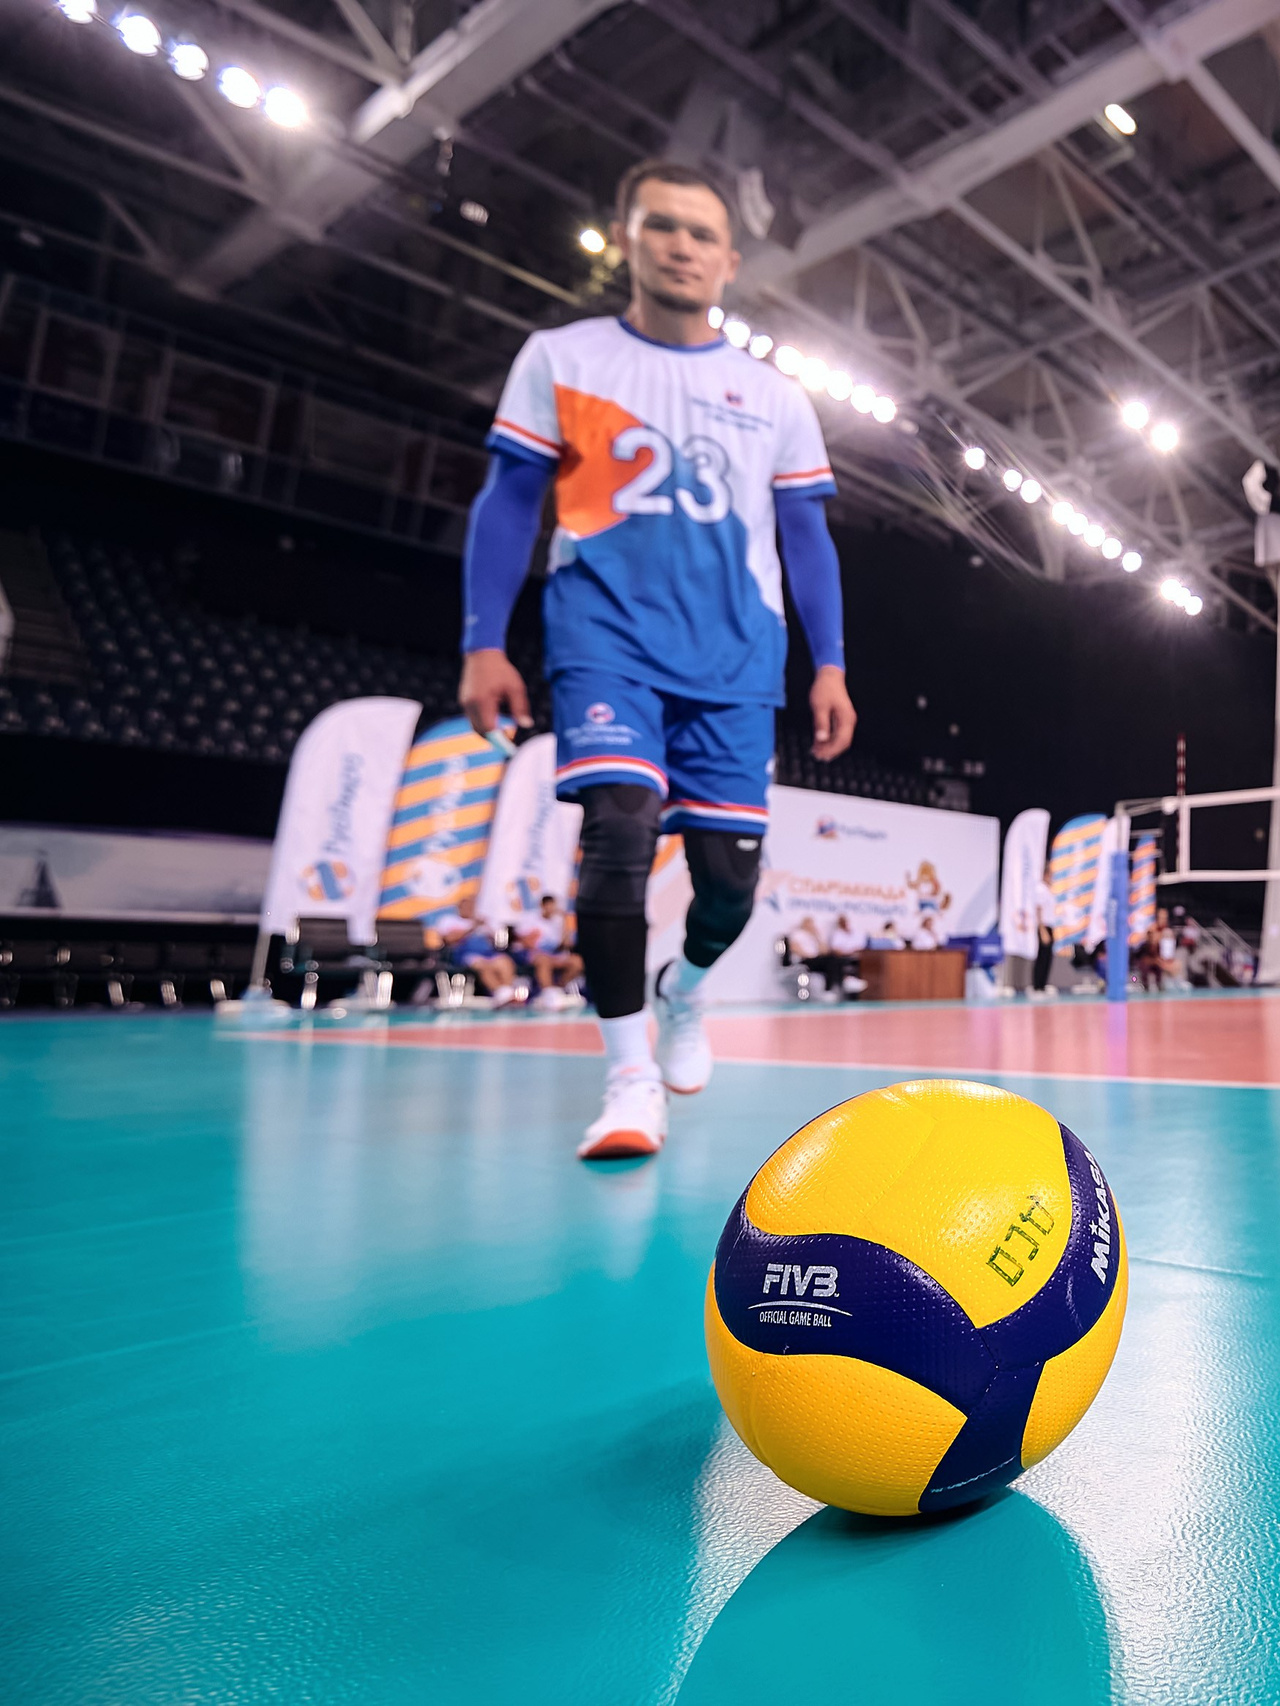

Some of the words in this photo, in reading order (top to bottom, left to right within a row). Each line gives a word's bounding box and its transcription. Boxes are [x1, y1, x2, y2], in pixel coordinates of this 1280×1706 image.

[611, 426, 731, 524] 23
[762, 1262, 839, 1297] FIVB
[759, 1310, 788, 1325] OFFICIAL
[789, 1311, 812, 1327] GAME
[813, 1313, 832, 1328] BALL
